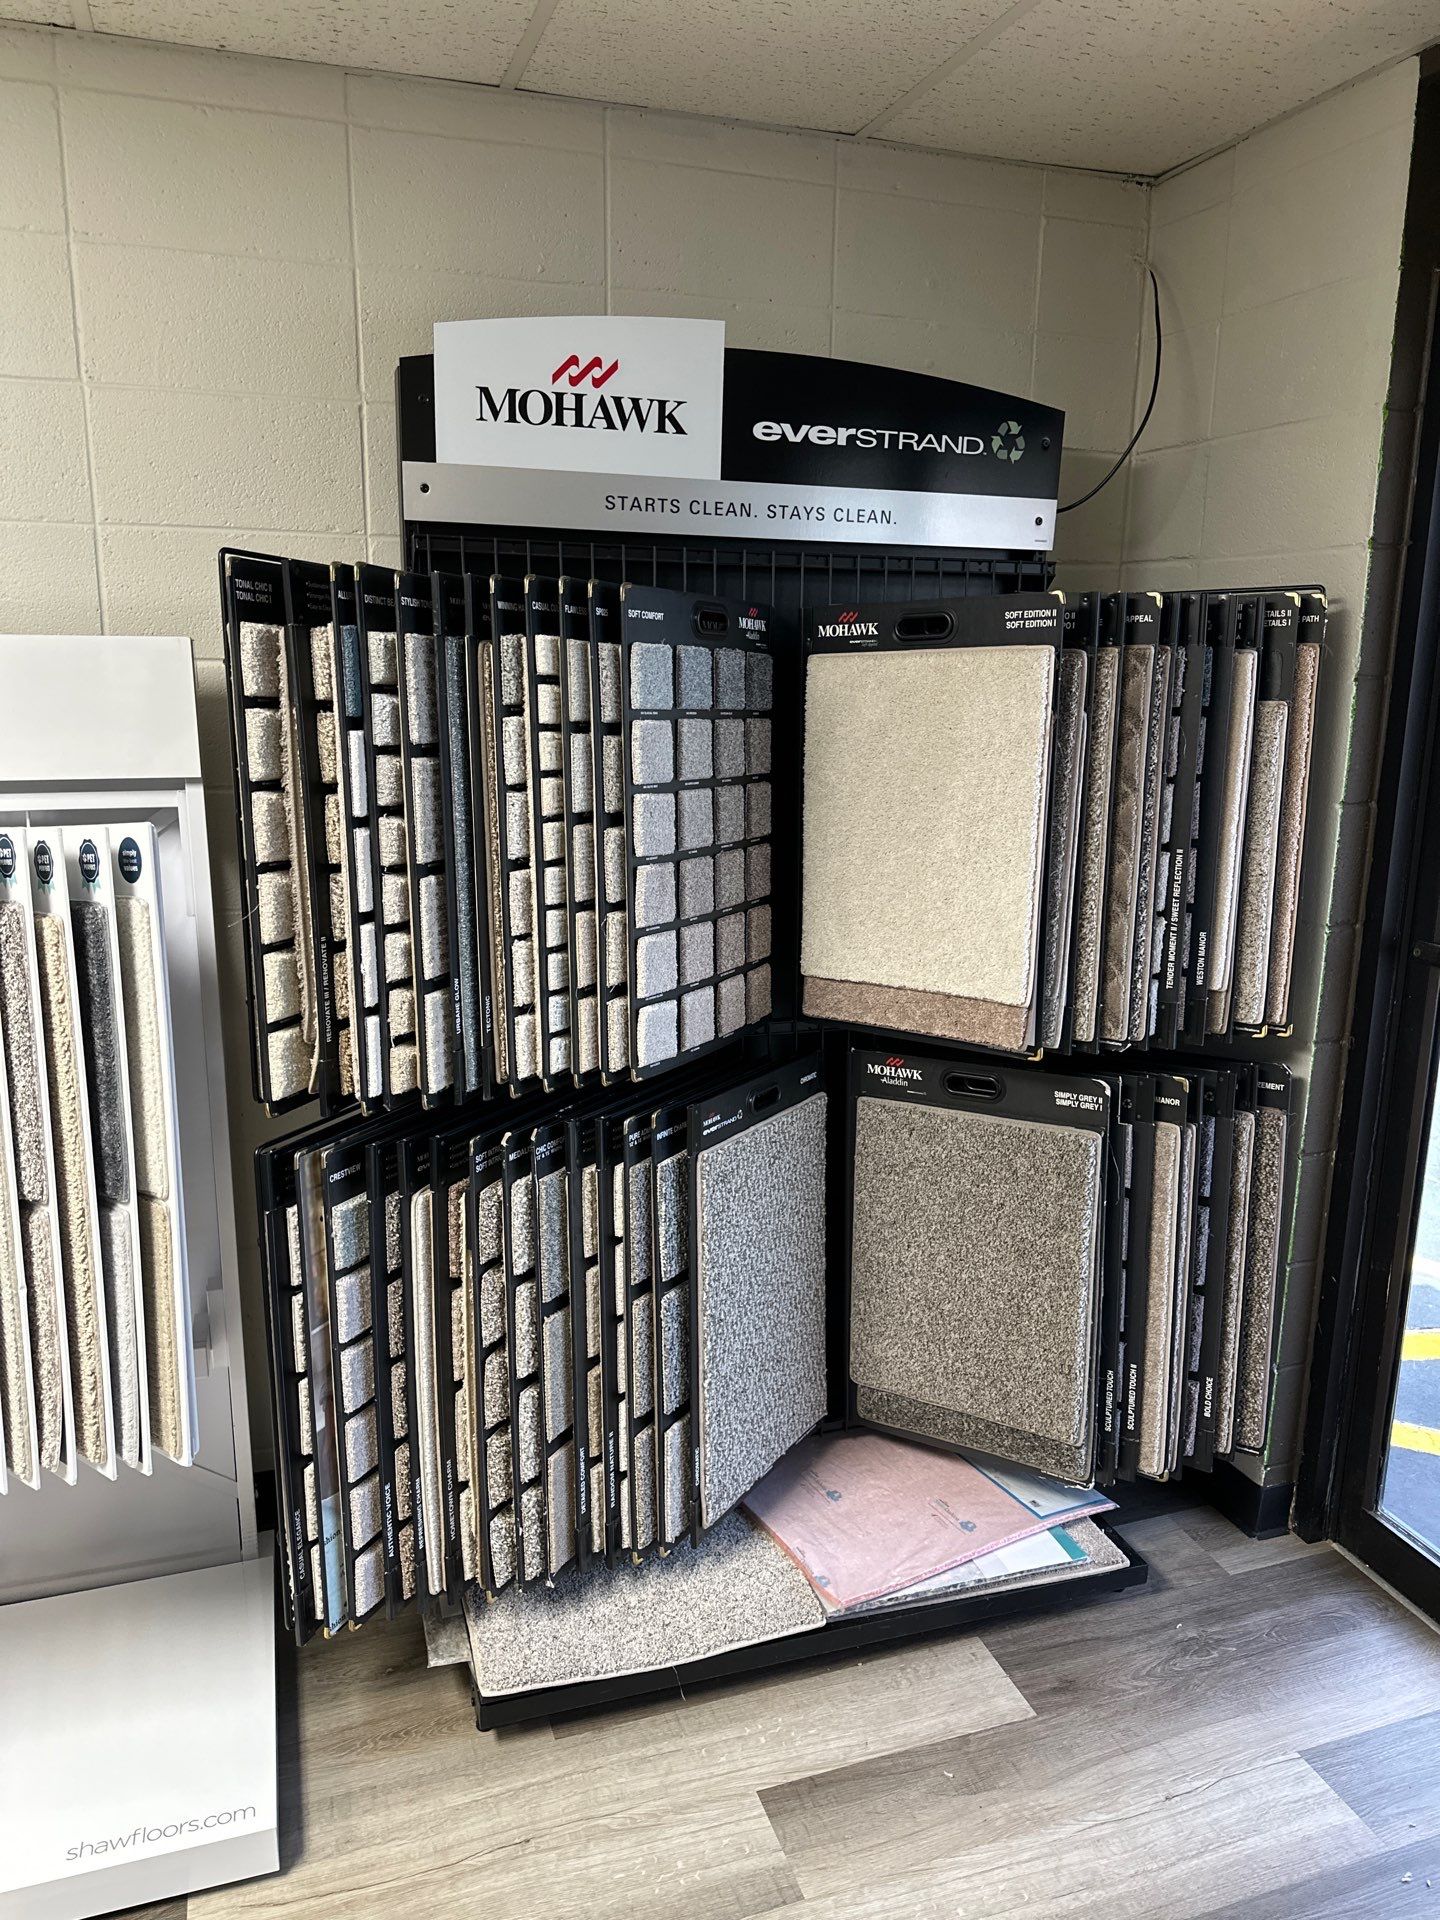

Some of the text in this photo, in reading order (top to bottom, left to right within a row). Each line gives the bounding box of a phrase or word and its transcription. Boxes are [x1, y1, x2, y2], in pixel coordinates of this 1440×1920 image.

[476, 386, 688, 435] MOHAWK
[605, 494, 897, 525] STARTS CLEAN. STAYS CLEAN.
[235, 578, 254, 590] TONAL
[254, 581, 267, 592] CHIC
[236, 590, 255, 602] TONAL
[255, 593, 269, 603] CHIC
[364, 594, 386, 606] DISTINCT
[532, 600, 550, 612] CASUAL
[1005, 609, 1057, 620] SOFT EDITION II
[1287, 609, 1292, 617] II
[628, 609, 664, 621] SOFT COMFORT
[1302, 615, 1320, 623] PATH
[738, 616, 767, 632] MOHAWK
[818, 622, 879, 638] MOHAWK
[1006, 619, 1057, 629] SOFT EDITION I
[1172, 854, 1183, 897] REFLECTION
[1171, 898, 1180, 922] SWEET
[1168, 932, 1177, 962] MOMENT
[321, 942, 329, 986] RENOVATE
[1196, 931, 1207, 986] WESTON MANOR
[1166, 962, 1175, 990] TENDER
[324, 999, 332, 1043] RENOVATE
[867, 1063, 923, 1081] MOHAWK
[880, 1076, 909, 1087] Aladdin
[1054, 1090, 1103, 1104] SIMPLY GREY II
[1055, 1098, 1079, 1108] SIMPLY
[1080, 1102, 1099, 1111] GREY
[629, 1131, 641, 1142] PURE
[475, 1151, 488, 1164] SOFT
[535, 1143, 547, 1156] CHIC
[330, 1162, 361, 1183] CRESTVIEW
[475, 1161, 488, 1173] SOFT
[1129, 1369, 1137, 1390] TOUCH
[1104, 1370, 1114, 1432] SCULPTURED TOUCH
[1203, 1377, 1213, 1418] BOLD CHOICE
[1127, 1390, 1136, 1431] SCULPTURED
[448, 1490, 456, 1541] HOMETOWN
[386, 1510, 395, 1558] AUTHENTIC
[65, 1806, 256, 1861] shawfloors.com
